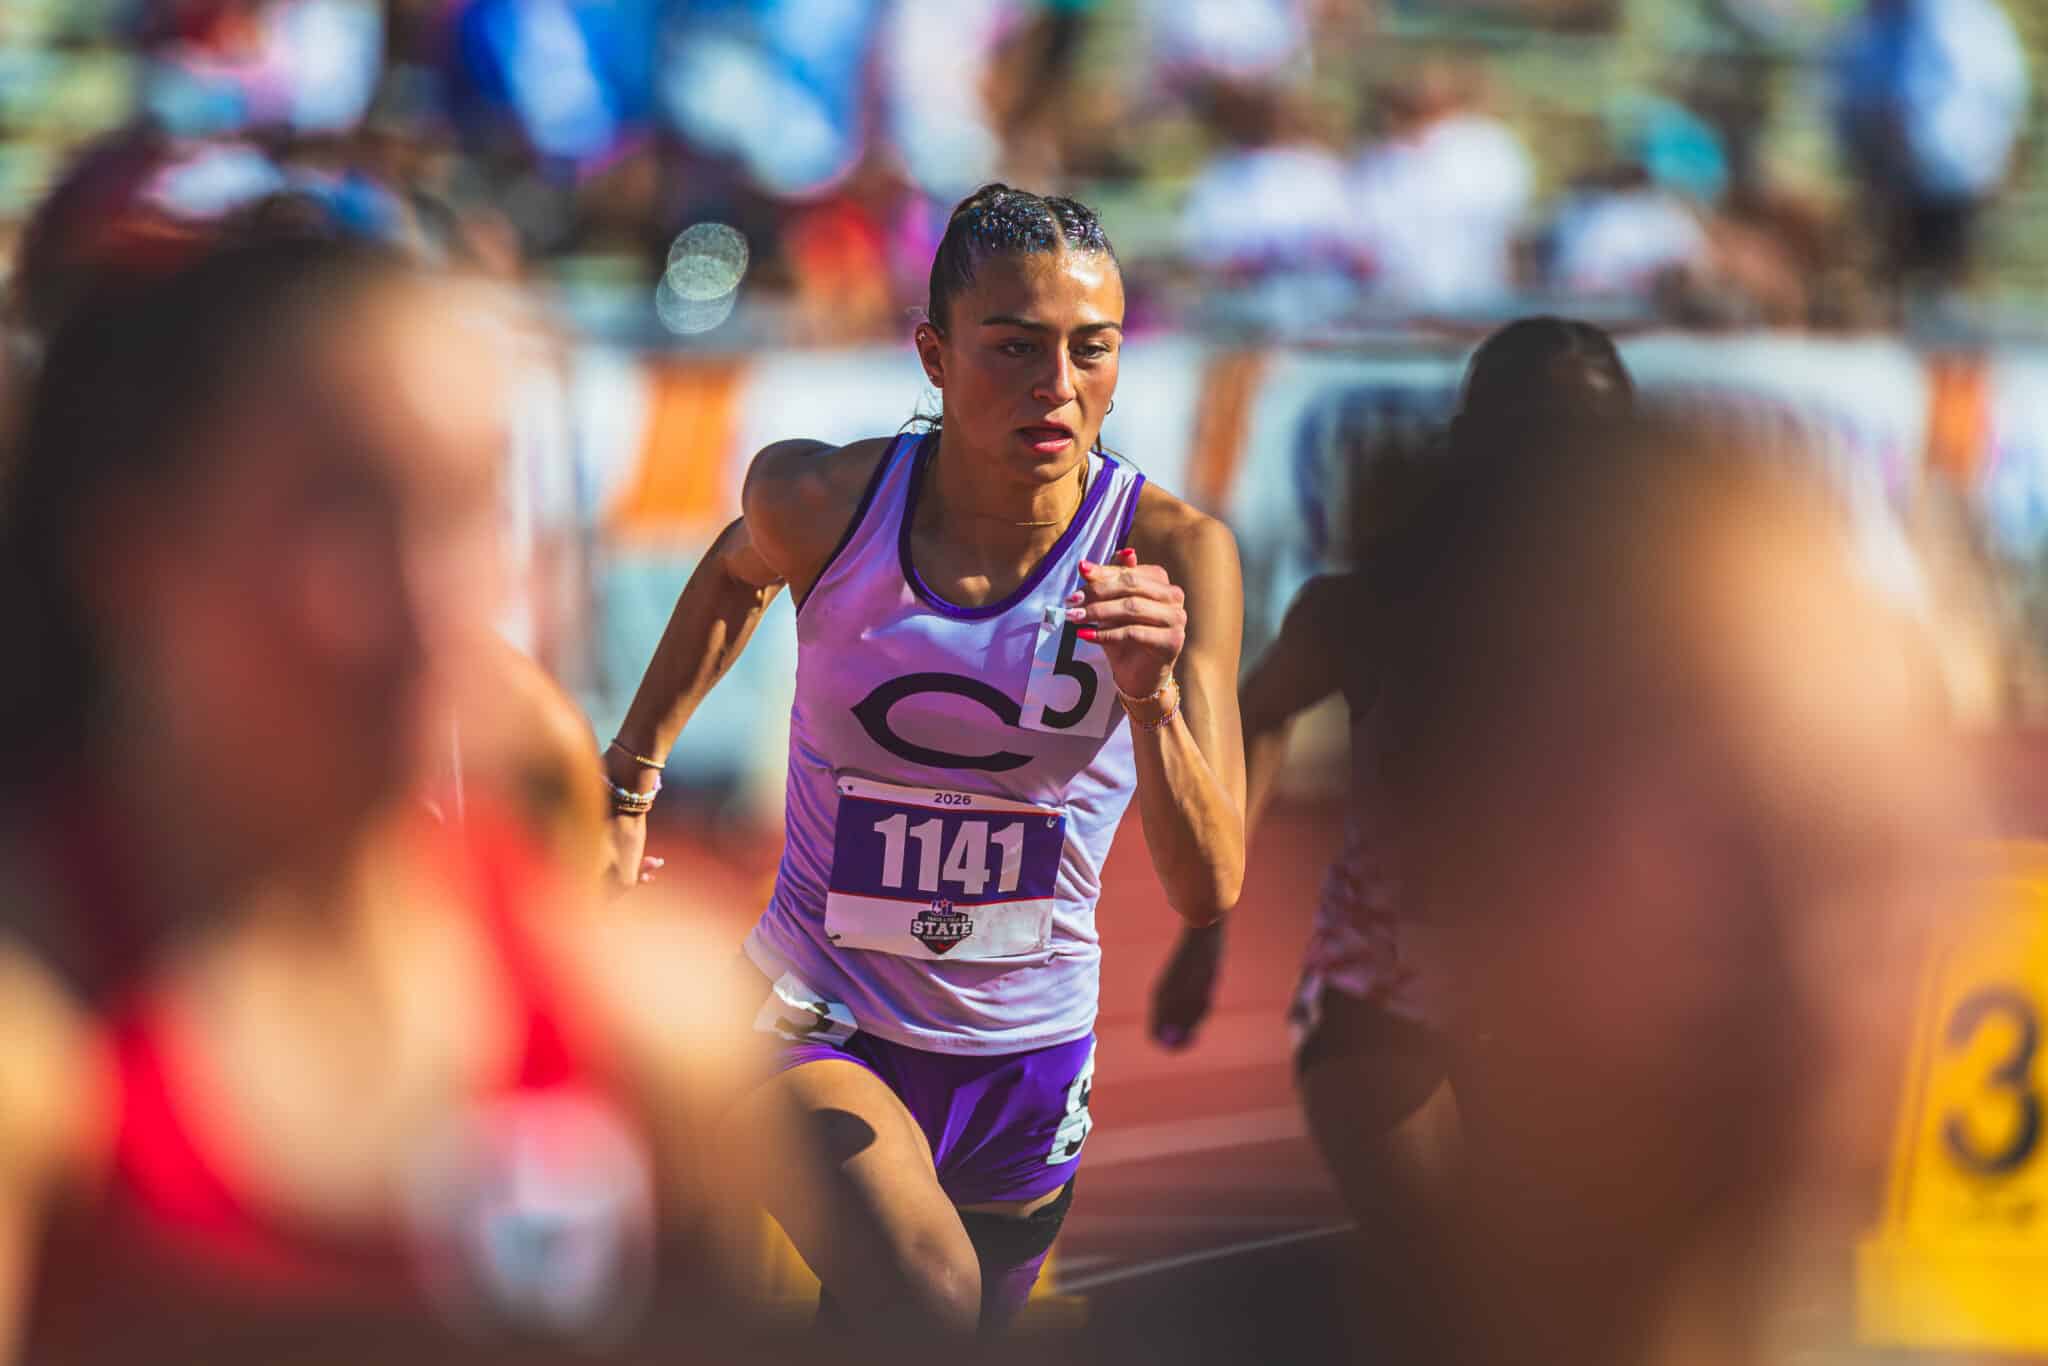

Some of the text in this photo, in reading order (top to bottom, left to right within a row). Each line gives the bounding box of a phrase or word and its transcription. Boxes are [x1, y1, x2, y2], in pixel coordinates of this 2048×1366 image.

[1041, 620, 1098, 729] 5
[850, 672, 1034, 771] C
[934, 792, 972, 806] 2026
[873, 813, 1025, 895] 1141
[912, 920, 972, 935] STATE
[1942, 984, 2042, 1178] 3
